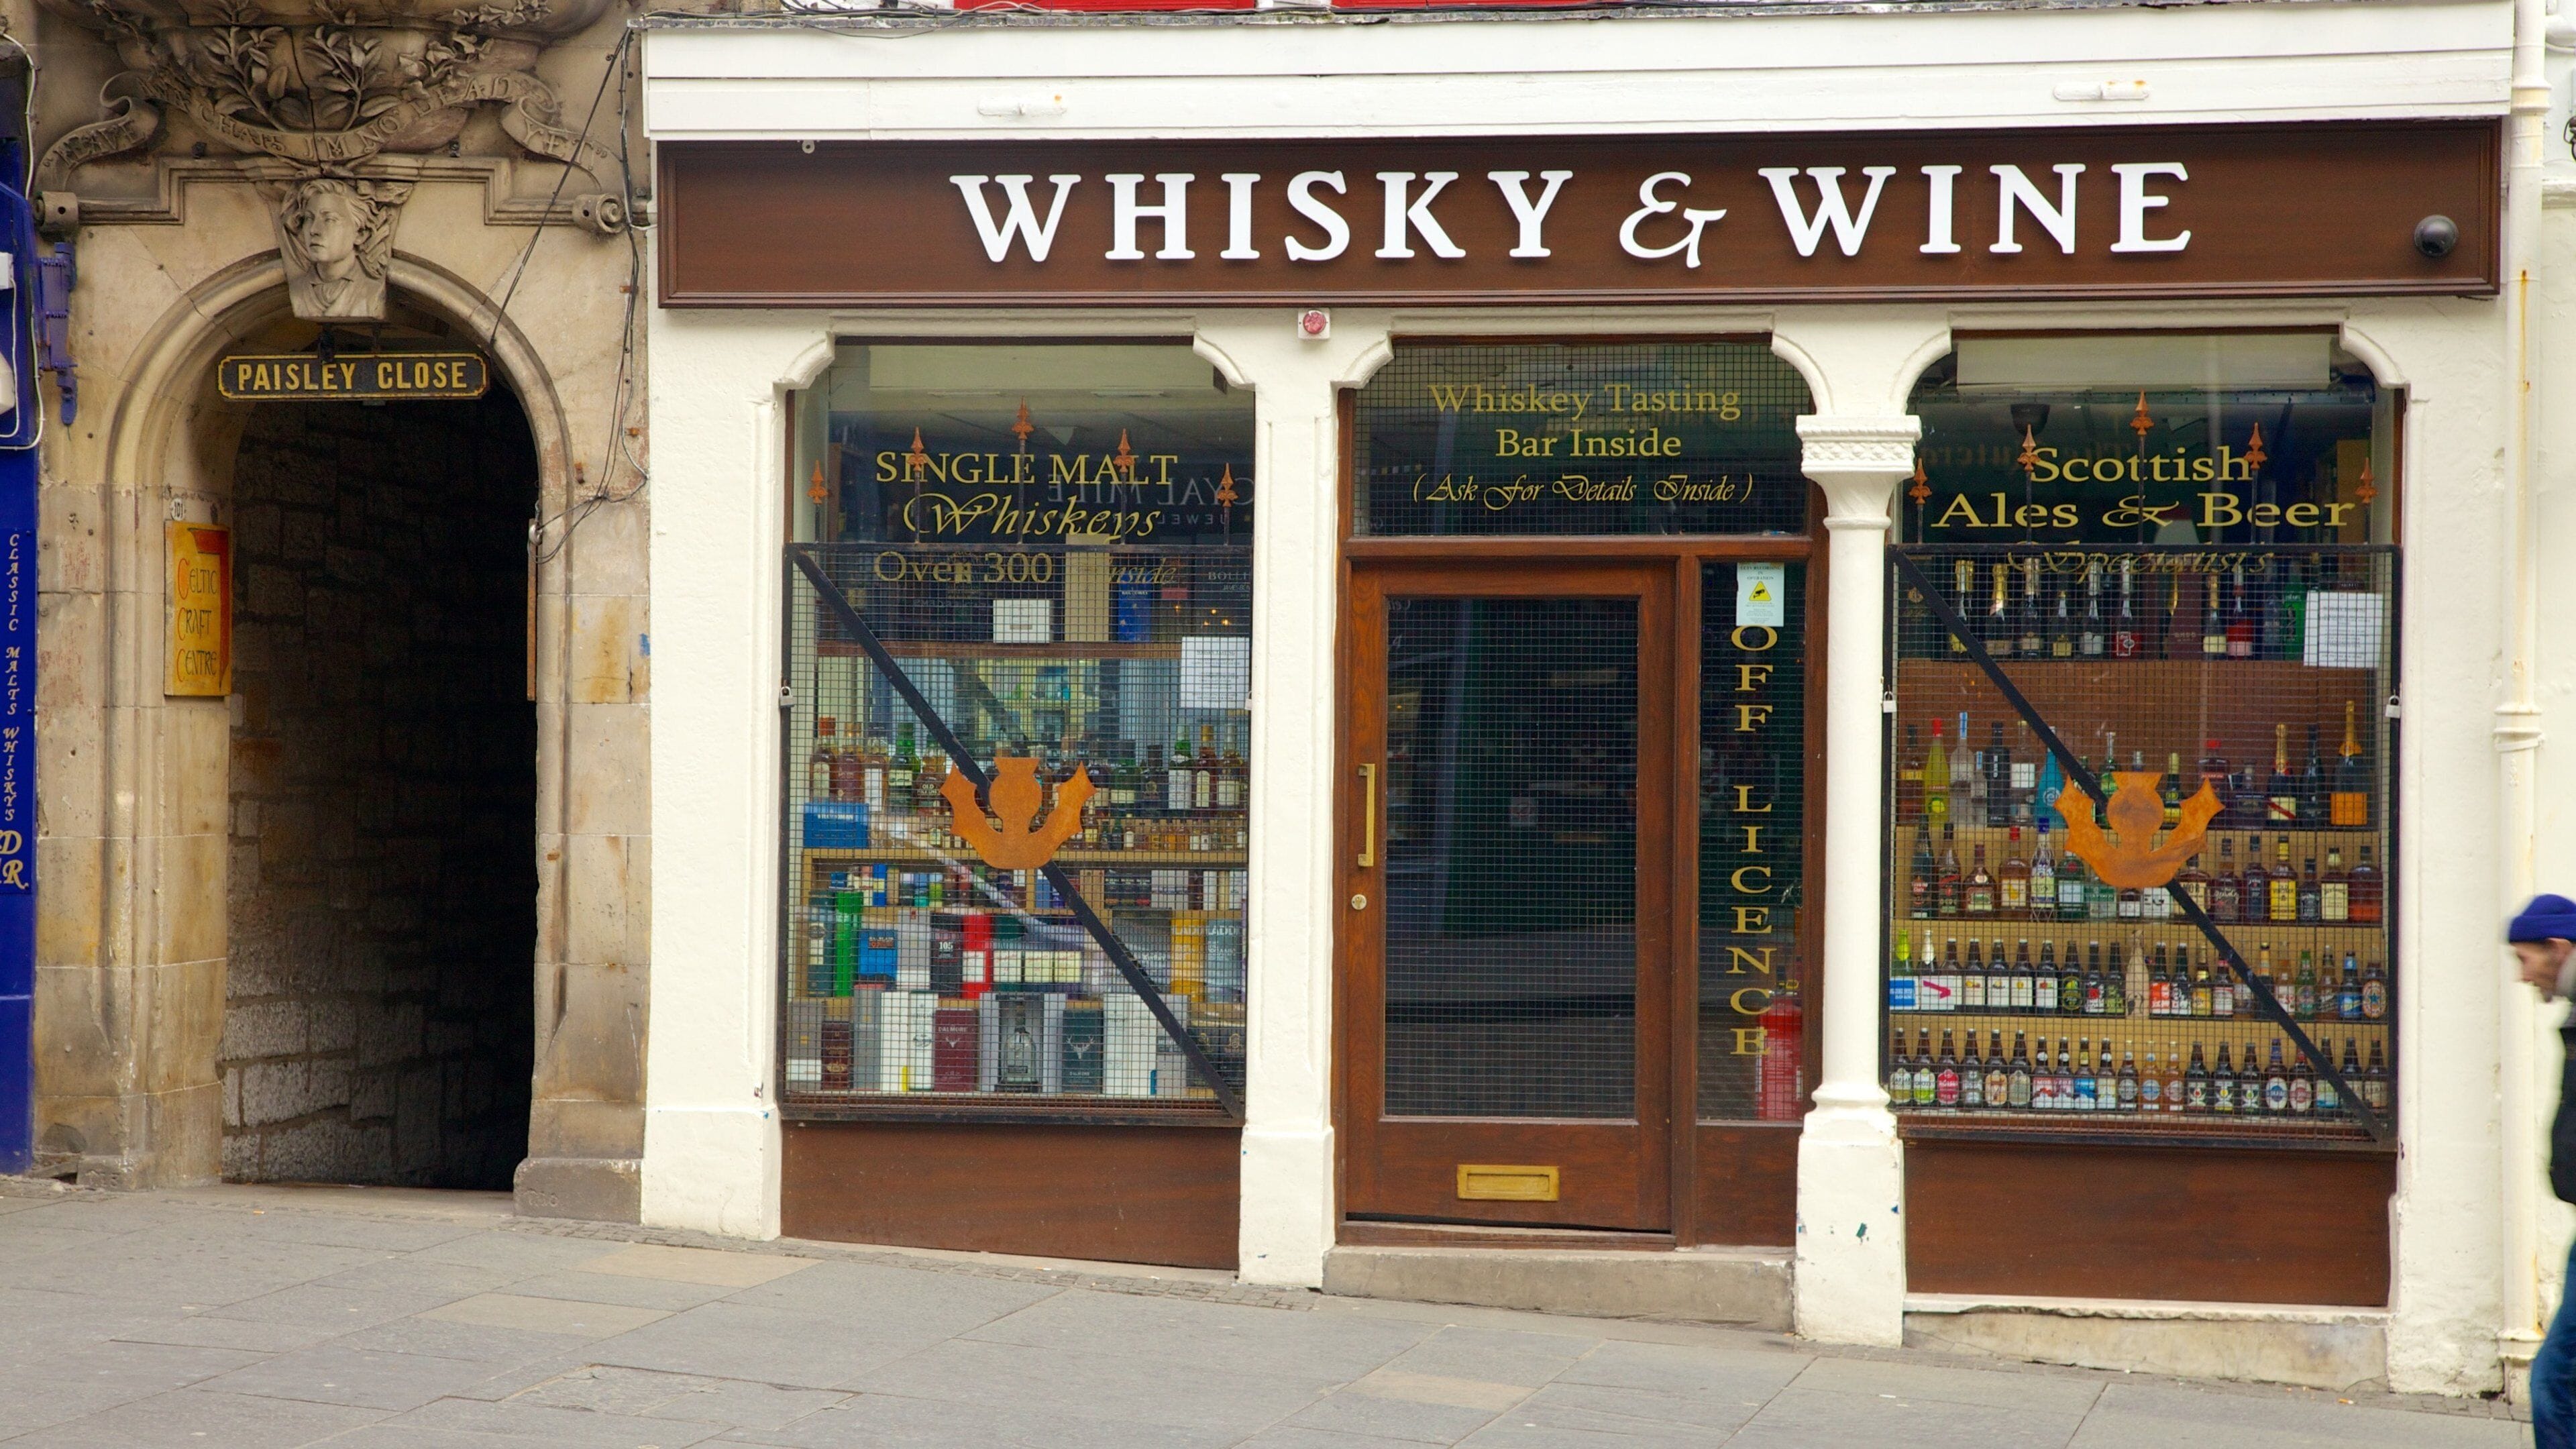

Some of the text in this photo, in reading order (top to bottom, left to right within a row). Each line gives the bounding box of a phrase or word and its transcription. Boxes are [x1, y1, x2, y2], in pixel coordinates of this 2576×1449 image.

[949, 162, 2192, 269] WHISKY & WINE
[237, 361, 468, 392] PAISLEY CLOSE
[1428, 382, 1742, 421] Whiskey Tasting
[1495, 427, 1682, 457] Bar Inside
[876, 451, 1178, 486] SINGLE MALT
[2029, 446, 2254, 482] Scottish
[1483, 474, 1545, 510] For
[1551, 473, 1638, 502] Details
[1654, 473, 1736, 502] Inside
[903, 492, 1161, 545] Whiskeys
[1930, 492, 2357, 528] Ales & Beer
[5, 533, 20, 632] CLASSIC
[177, 557, 217, 600] CELTIC
[874, 550, 972, 584] Over
[983, 552, 1054, 584] 300
[176, 606, 212, 641] CRAFT
[5, 646, 21, 716] MALTS
[176, 648, 217, 683] CENTRE
[1731, 625, 1778, 732] OFF
[1726, 785, 1778, 1057] LICENCE
[938, 941, 954, 951] 105
